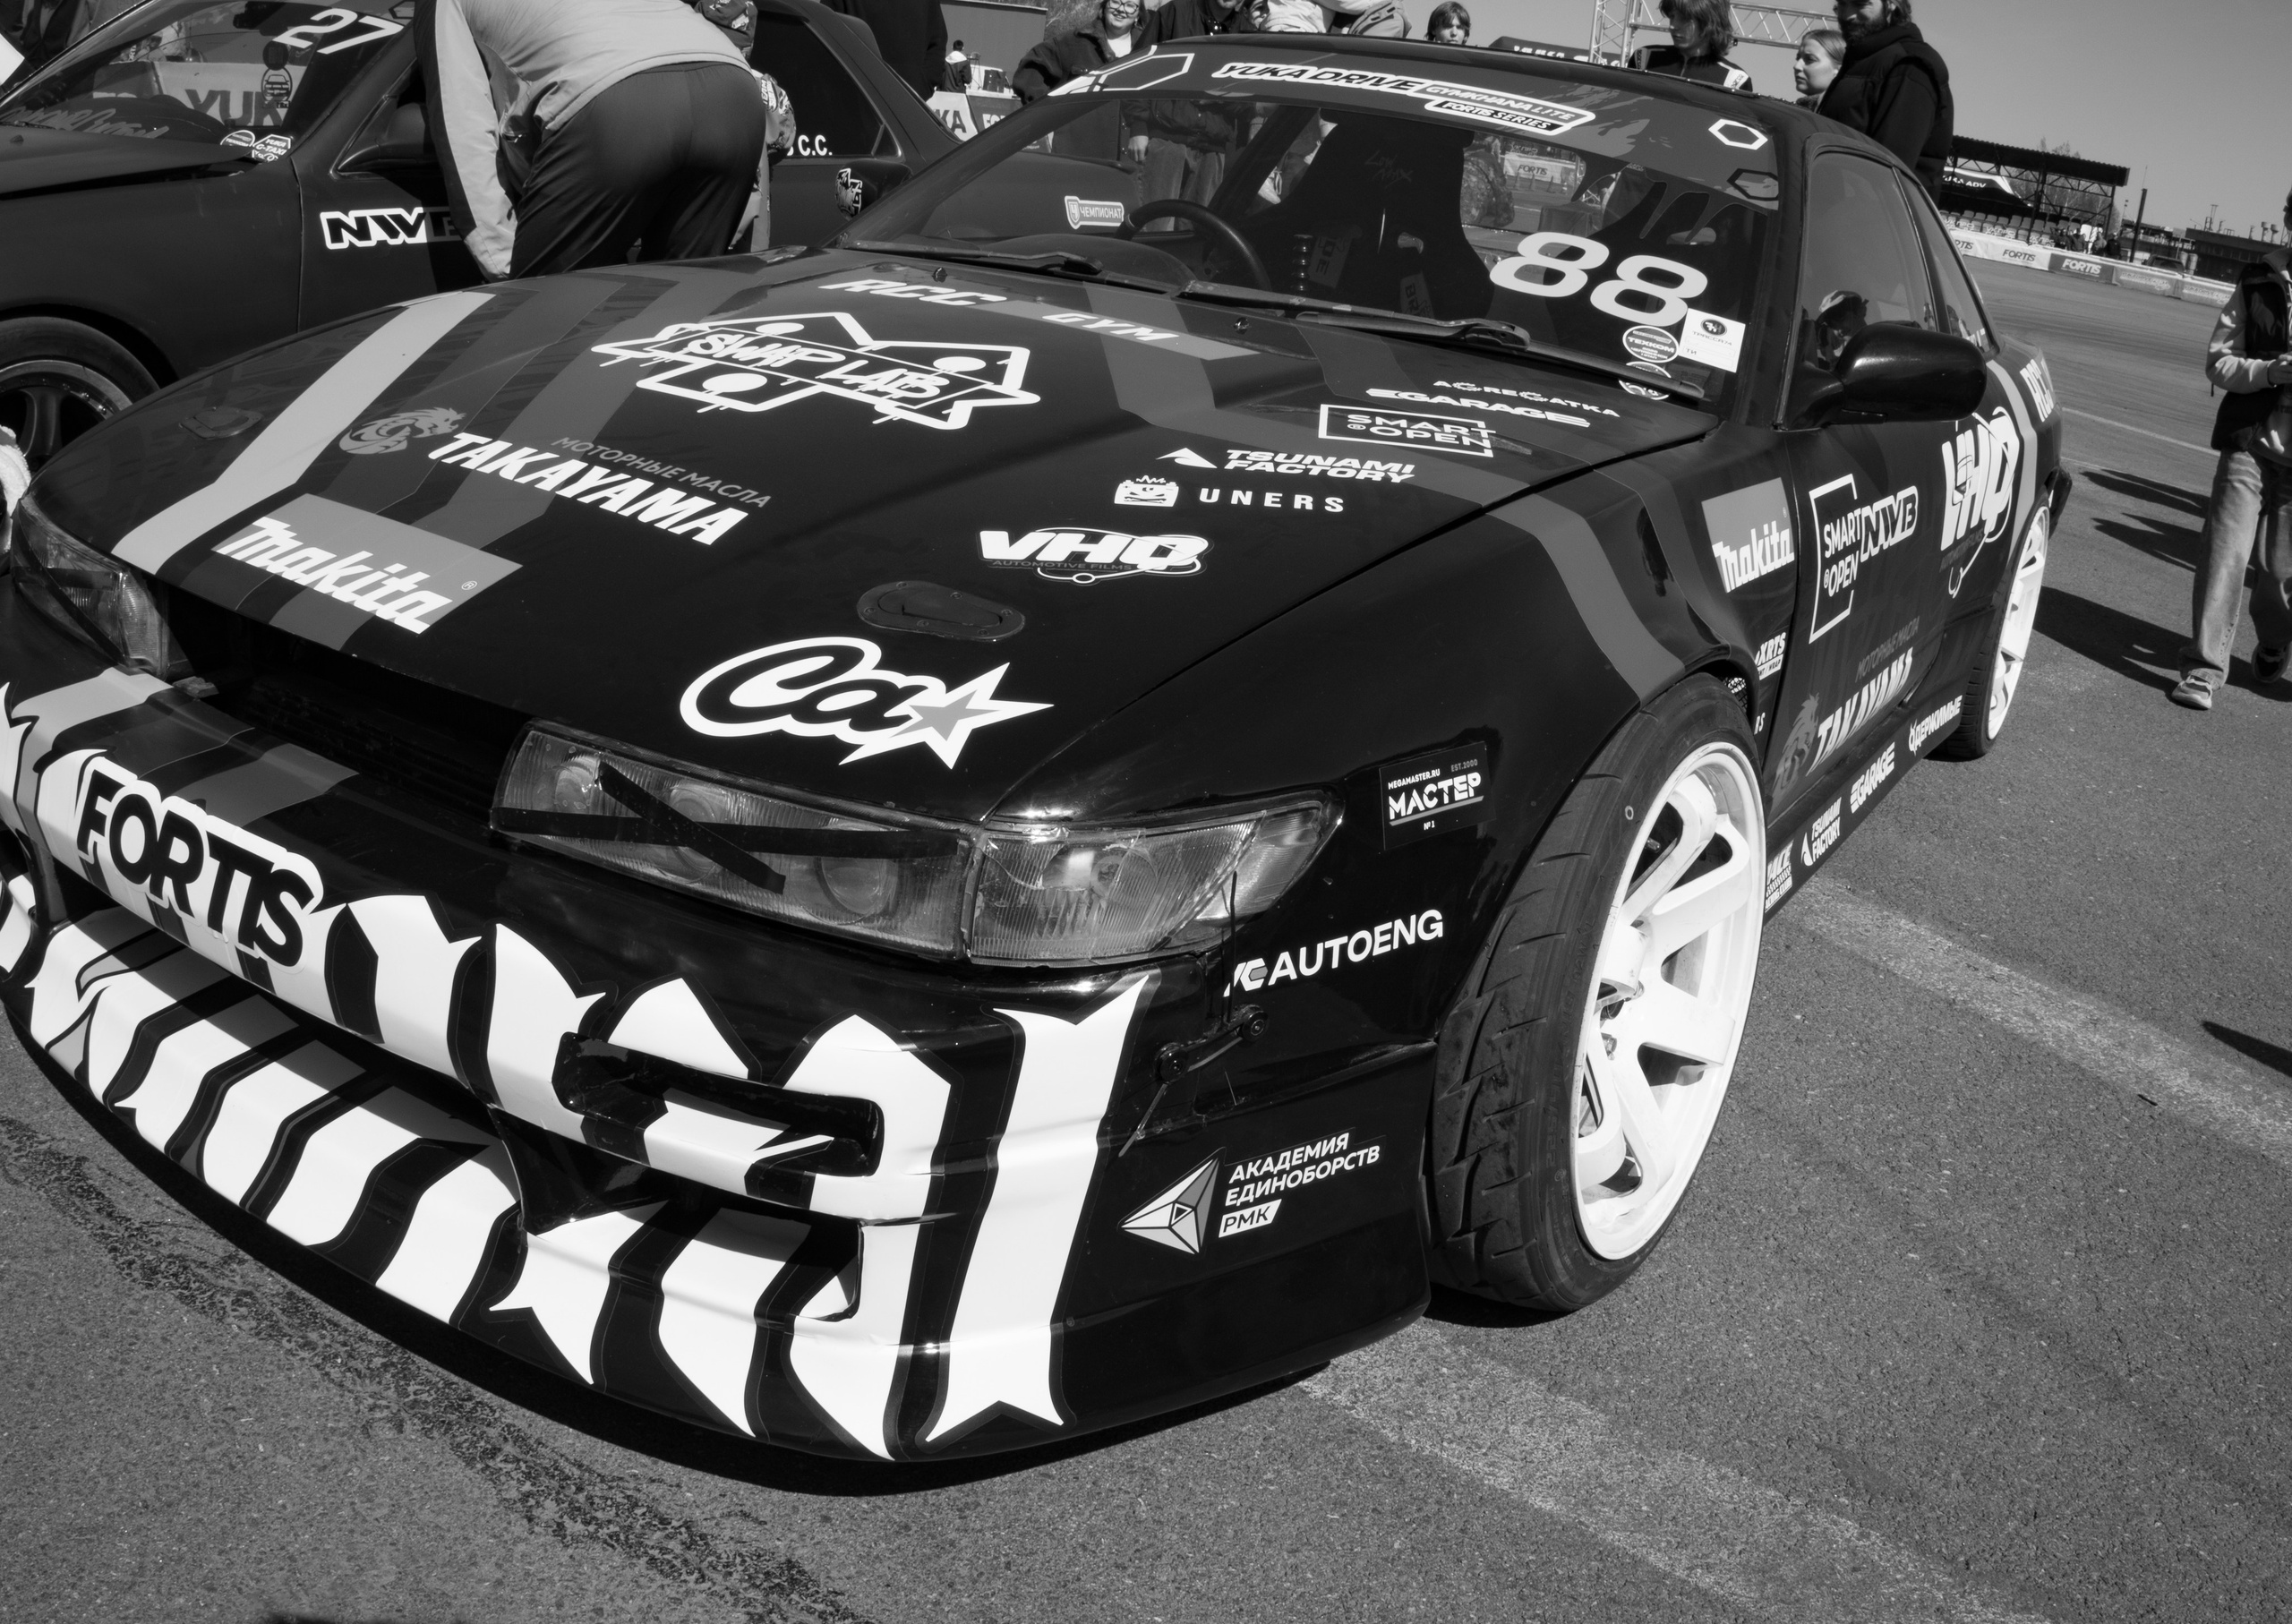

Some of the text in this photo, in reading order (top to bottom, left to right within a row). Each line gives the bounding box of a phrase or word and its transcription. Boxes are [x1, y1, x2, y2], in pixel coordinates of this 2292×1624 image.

[273, 8, 406, 54] 27
[1220, 65, 1425, 90] YUKA DRIVE
[184, 90, 285, 126] YUK
[1426, 86, 1575, 121] GYMKHANA LITE
[1442, 101, 1551, 129] FORTIS SERIES
[256, 144, 287, 155] G-TAXI
[1517, 164, 1548, 175] FORTIS
[1942, 175, 1987, 188] UKA ADV
[1080, 206, 1121, 219] ЧЕМПИОНАТ
[2002, 249, 2037, 262] FORTIS
[2062, 258, 2102, 275] FORTIS
[1489, 231, 1708, 327] 88
[1042, 312, 1180, 341] GYM
[1347, 414, 1496, 438] SMART
[551, 437, 772, 508] МОТОРНЫЕ МАСЛА
[1224, 459, 1415, 483] FACTORY
[1226, 449, 1415, 474] TSUNAMI
[428, 432, 748, 545] TAKAYAMA
[1199, 488, 1344, 513] UNERS
[1824, 508, 1860, 559] SMART
[992, 560, 1133, 570] AUTOMOTIVE FILMS
[1711, 520, 1795, 594] makita
[216, 517, 453, 635] makita
[1388, 768, 1441, 790] MEGAMASTER.RU
[1451, 759, 1478, 772] EST.2000
[1389, 772, 1482, 820] МАСТЕР
[1811, 797, 1842, 842] TSUNAMI
[1812, 816, 1841, 863] FACTORY
[77, 769, 315, 967] FORTIS
[1268, 910, 1443, 986] AUTOENG
[1228, 1133, 1350, 1184] АКАДЕМИЯ
[1225, 1145, 1381, 1206] ЕДИНОБОРСТВ
[1223, 1204, 1271, 1234] РМК
